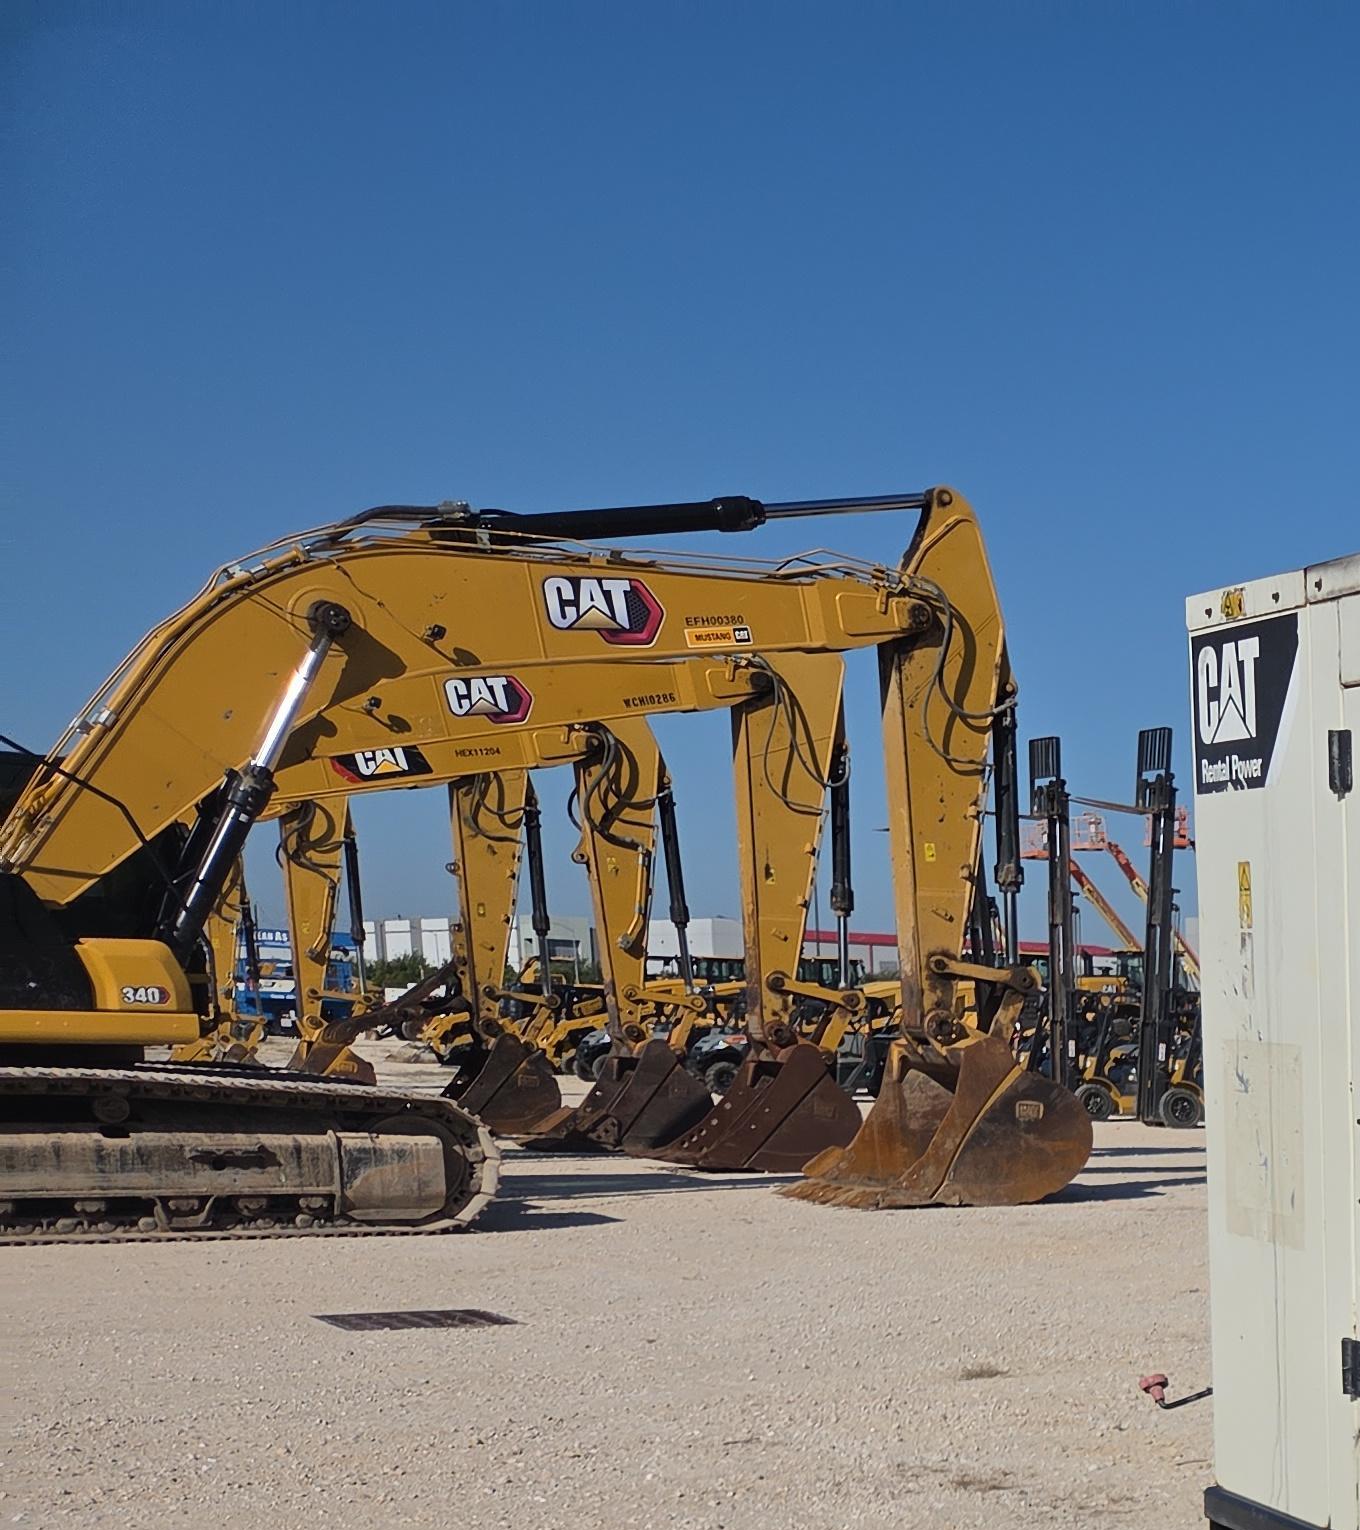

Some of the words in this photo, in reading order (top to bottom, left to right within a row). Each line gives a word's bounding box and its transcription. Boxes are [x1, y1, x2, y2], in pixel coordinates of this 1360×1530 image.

[543, 576, 631, 629] CAT
[685, 615, 745, 626] EFH00380
[694, 631, 732, 642] MUSTANG
[445, 676, 509, 716] CAT
[1198, 636, 1260, 745] CAT
[354, 747, 409, 776] CAT
[1202, 756, 1229, 785] Rental
[1231, 754, 1263, 781] Power
[122, 987, 160, 1004] 340
